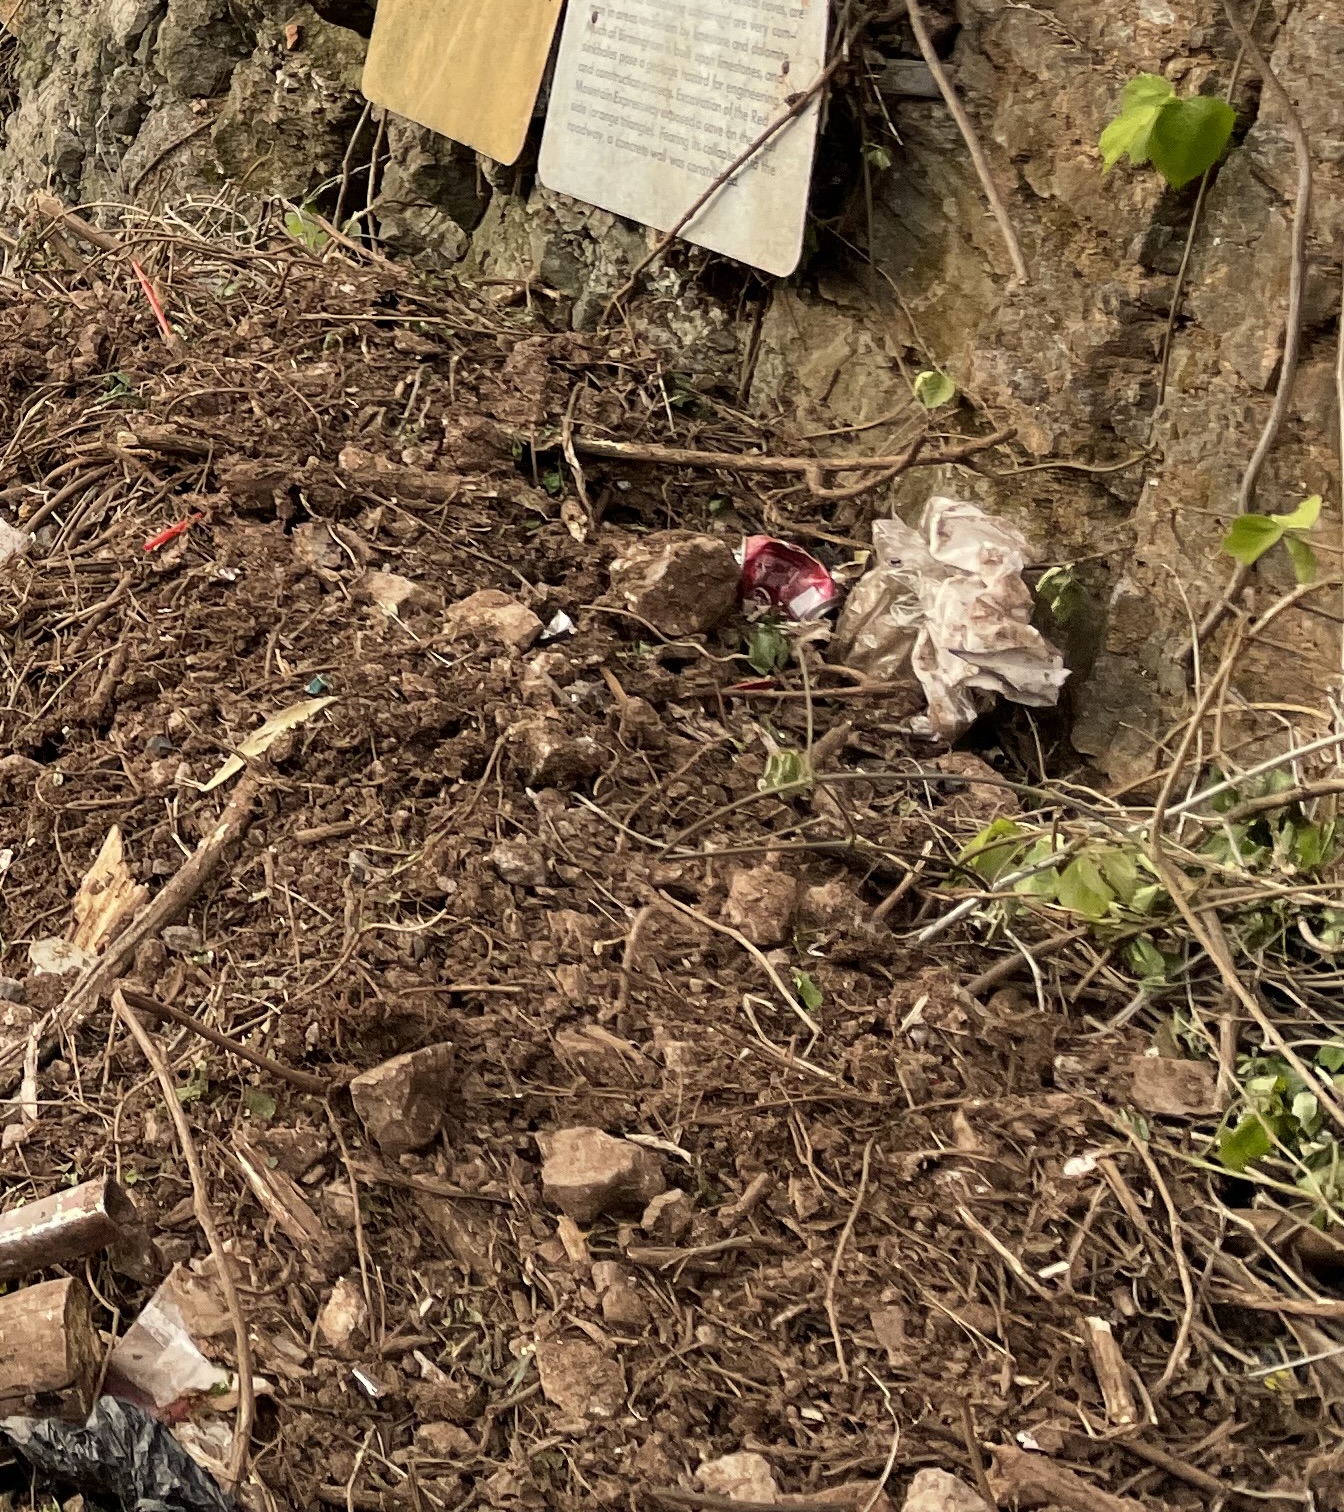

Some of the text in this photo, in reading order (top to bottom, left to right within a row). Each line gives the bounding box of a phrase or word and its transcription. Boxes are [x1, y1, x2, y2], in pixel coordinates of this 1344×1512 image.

[749, 21, 768, 39] very
[733, 103, 748, 122] the
[750, 108, 769, 128] Red
